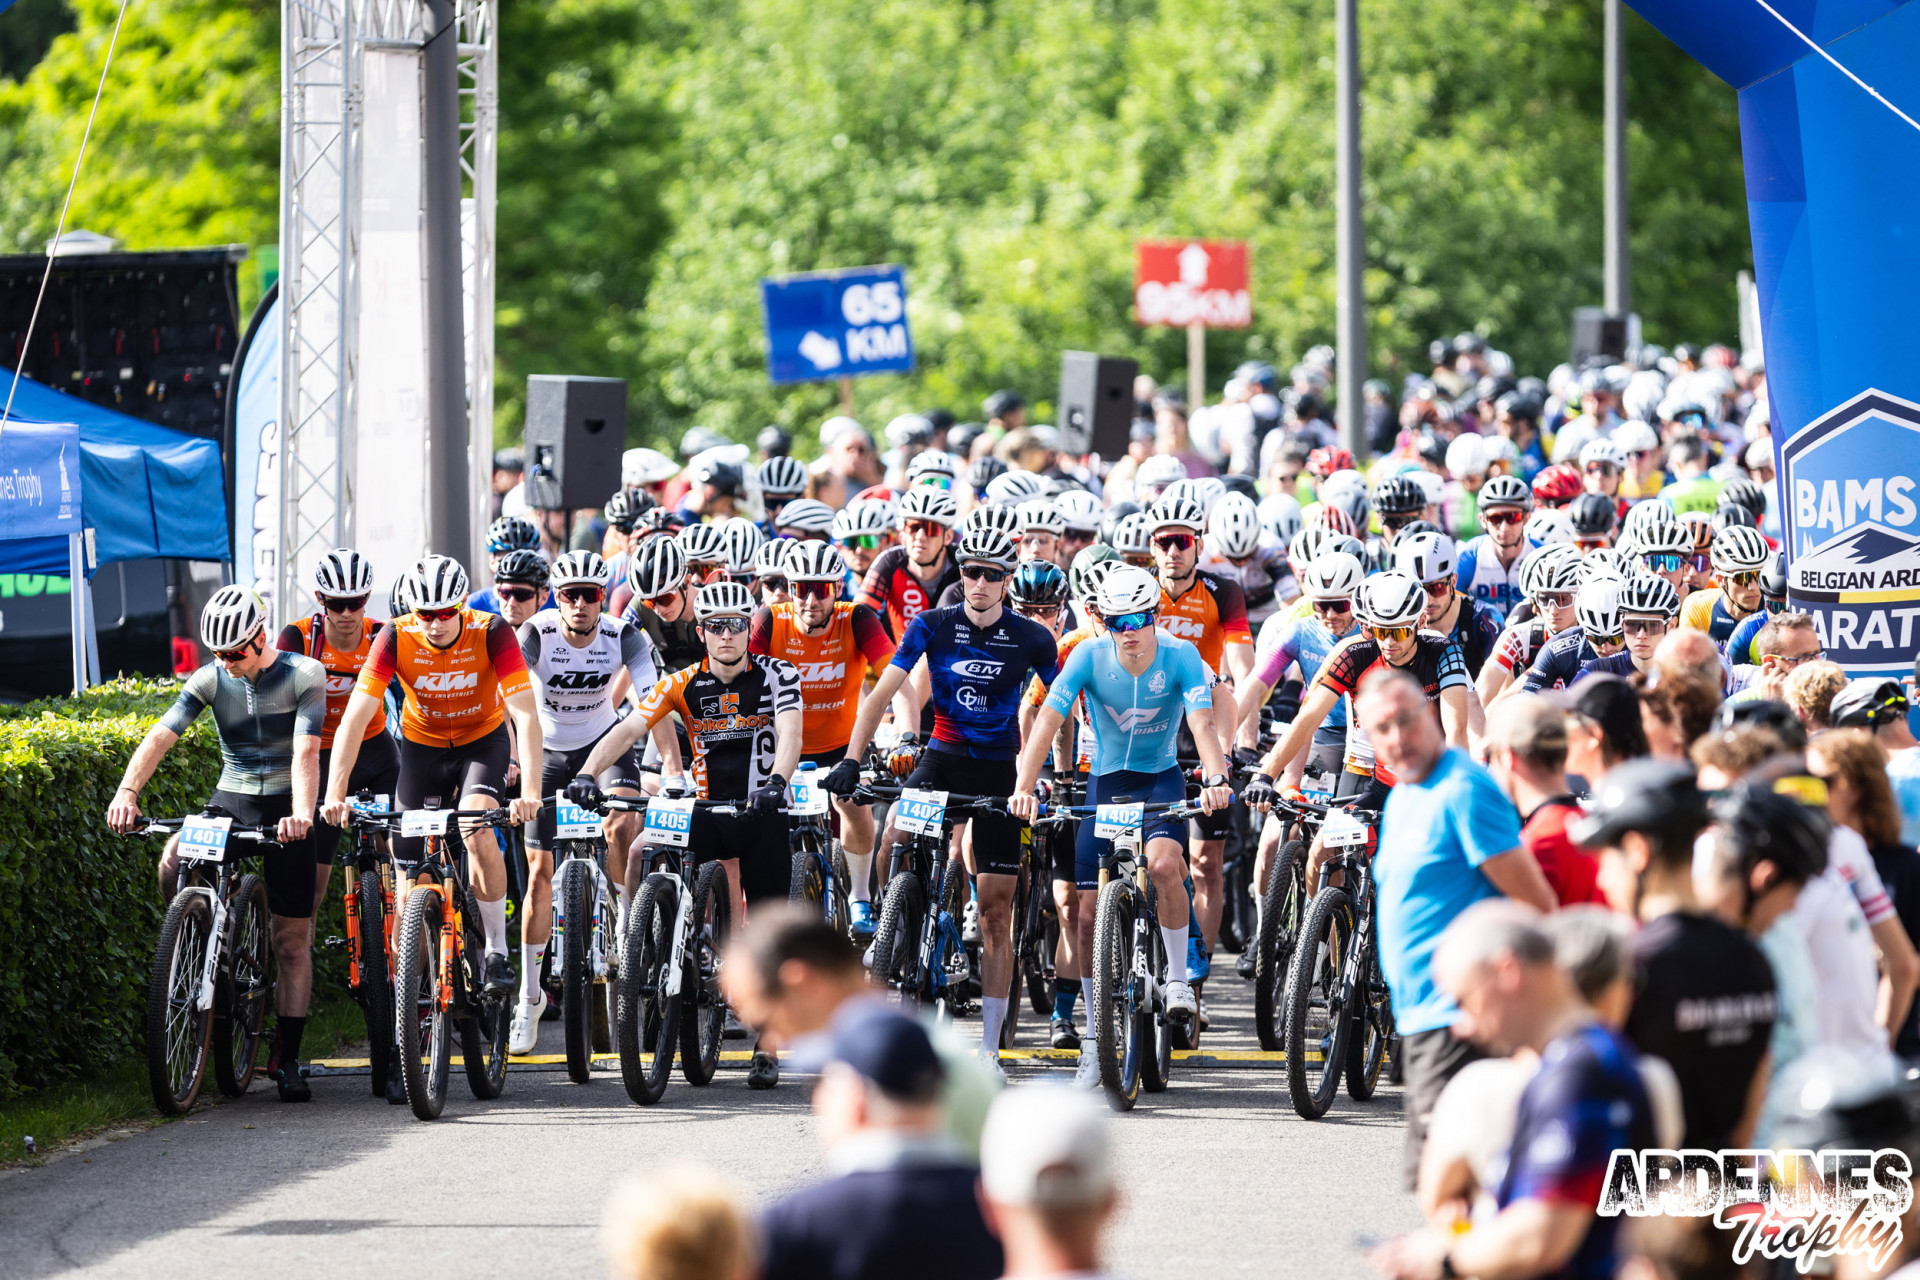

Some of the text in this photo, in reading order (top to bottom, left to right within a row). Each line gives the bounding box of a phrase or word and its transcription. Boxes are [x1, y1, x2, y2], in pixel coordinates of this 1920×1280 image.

[841, 281, 902, 326] 65
[846, 324, 908, 364] KM
[13, 466, 43, 507] Trophy
[1796, 476, 1917, 533] BAMS
[1801, 570, 1875, 589] BELGIAN
[542, 626, 556, 634] KTM
[600, 629, 618, 638] KTM
[1791, 605, 1920, 650] ARAT
[413, 670, 478, 691] KTM
[546, 670, 612, 689] KTM
[796, 661, 846, 681] KTM
[435, 690, 475, 699] INDUSTRIES
[506, 686, 516, 694] DT
[431, 704, 482, 718] G-SKIN
[1133, 722, 1169, 735] BIKES
[902, 801, 942, 820] 1400
[1100, 809, 1140, 825] 1402
[649, 811, 689, 830] 1405
[185, 828, 223, 845] 1401
